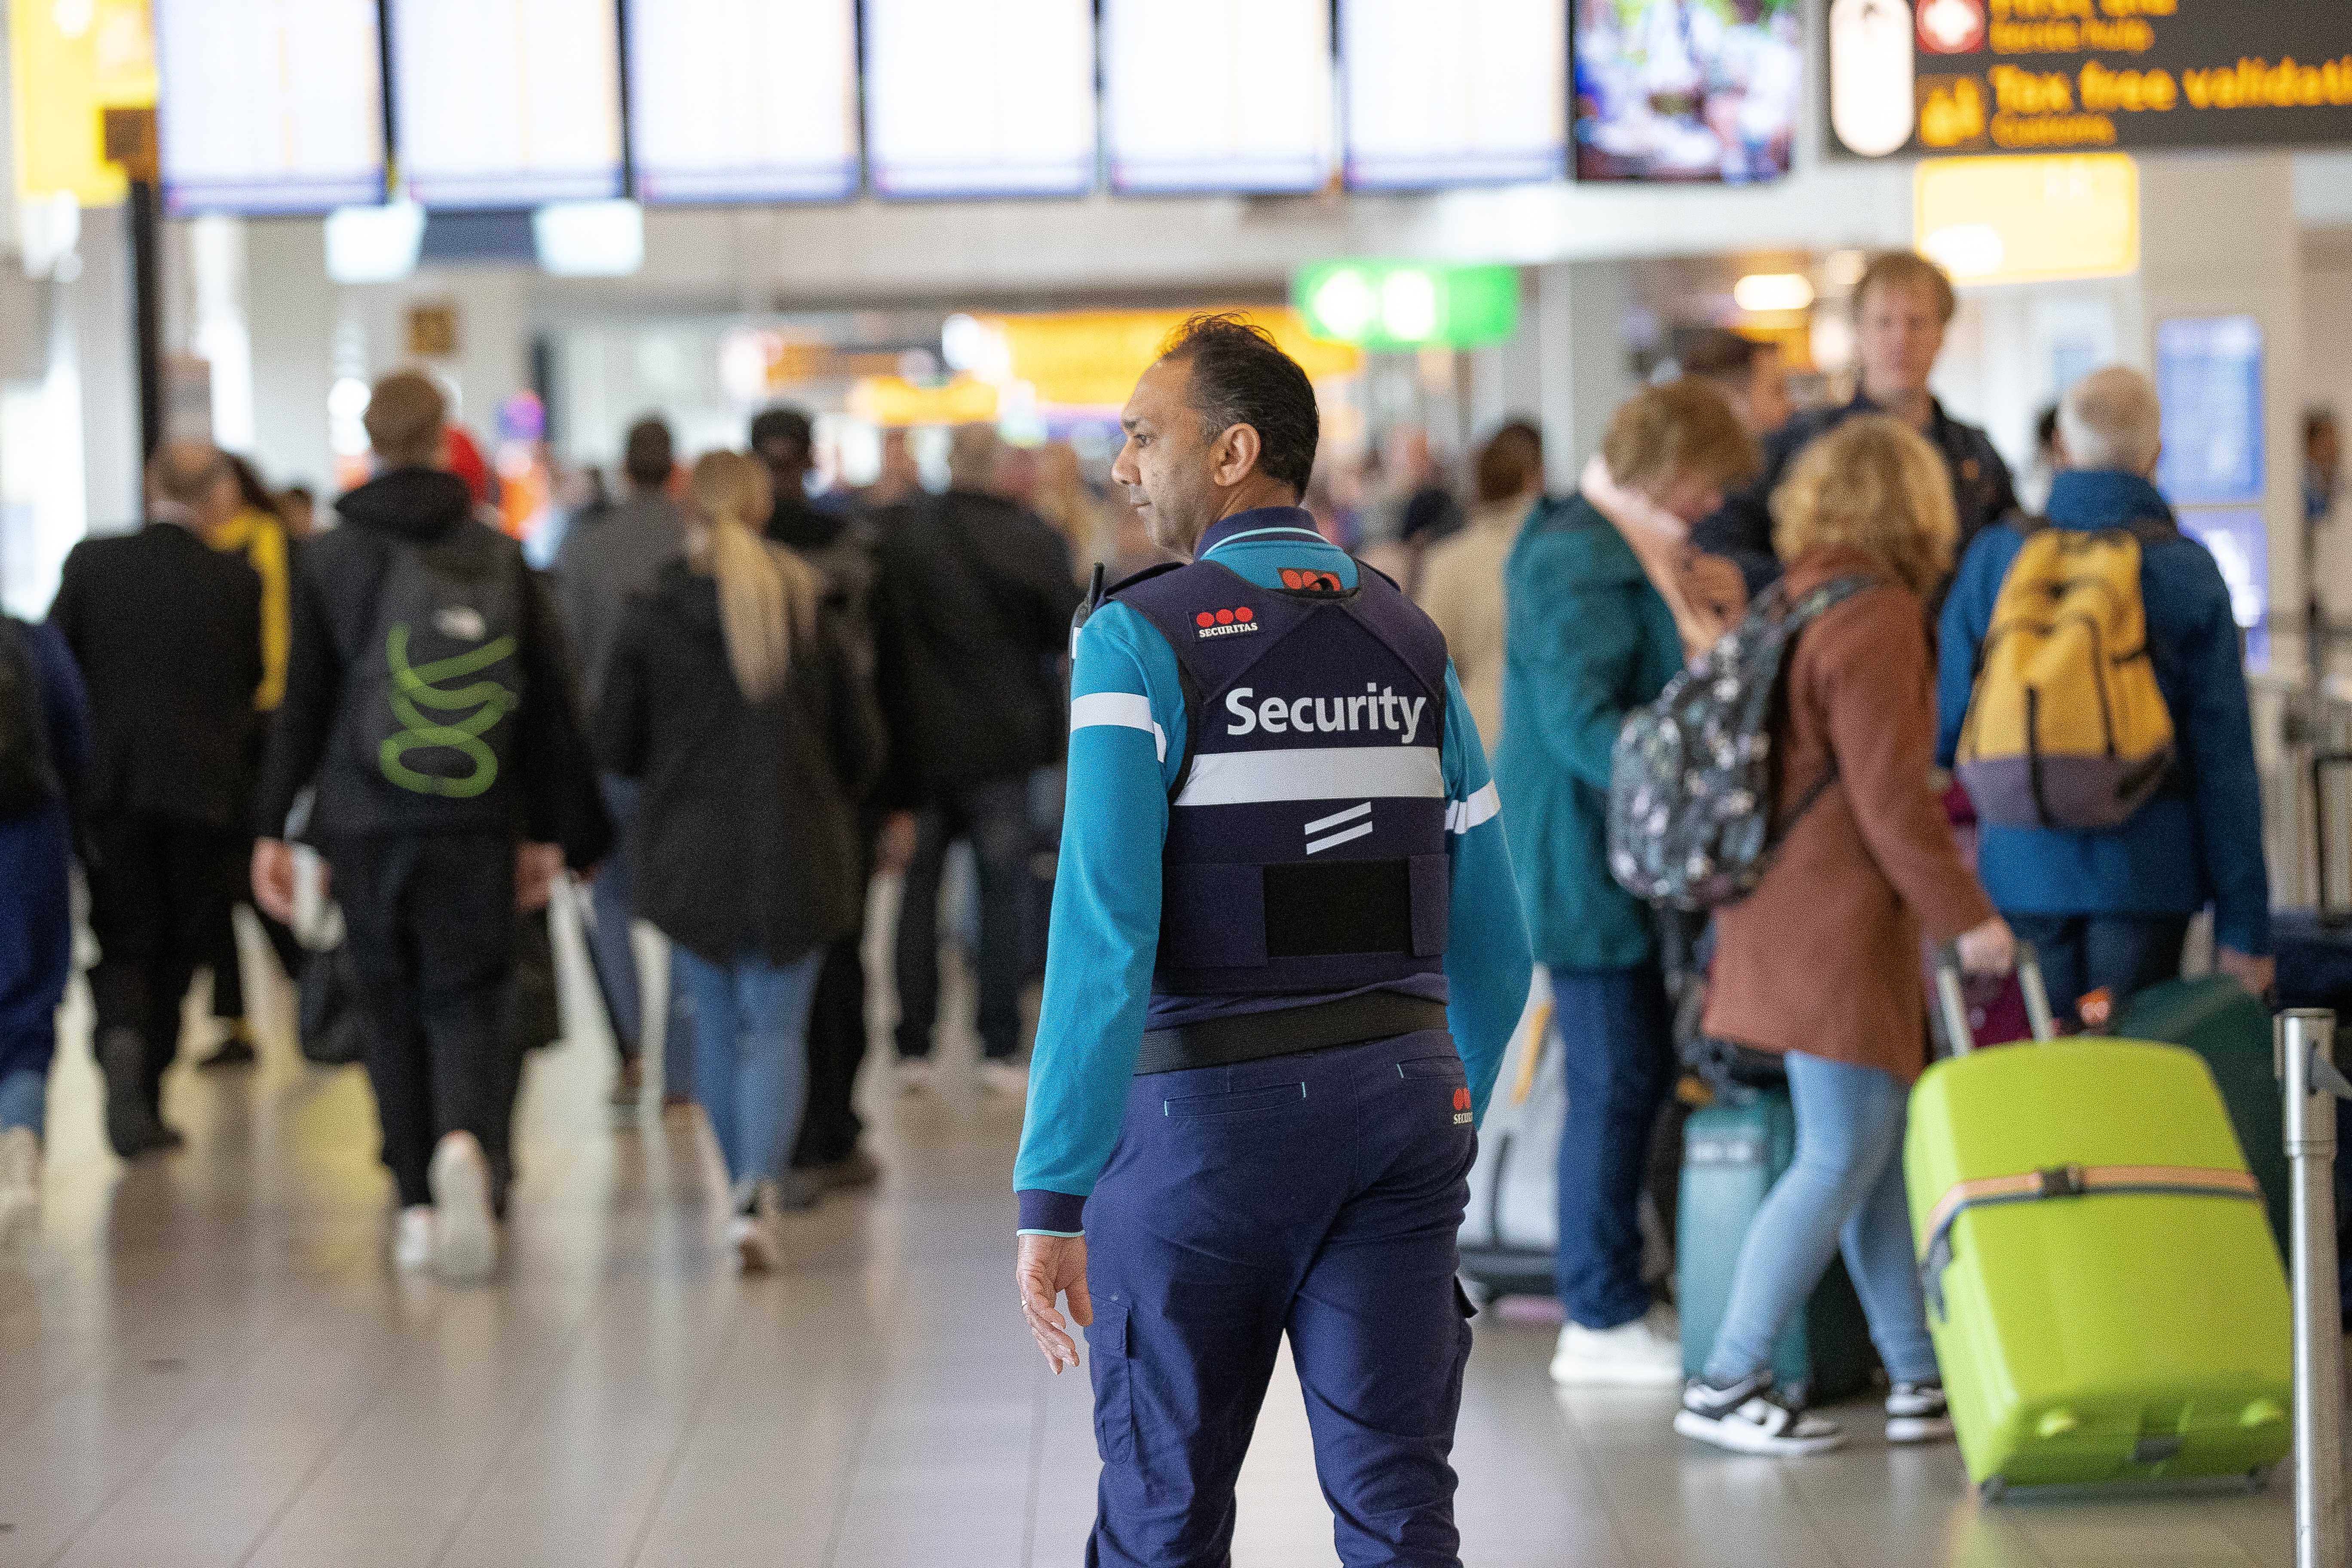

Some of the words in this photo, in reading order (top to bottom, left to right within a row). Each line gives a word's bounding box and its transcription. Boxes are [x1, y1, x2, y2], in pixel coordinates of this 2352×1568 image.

[1989, 64, 2072, 112] Tax
[2079, 60, 2176, 111] free
[1199, 622, 1258, 638] SECURITAS
[1225, 683, 1427, 744] Security
